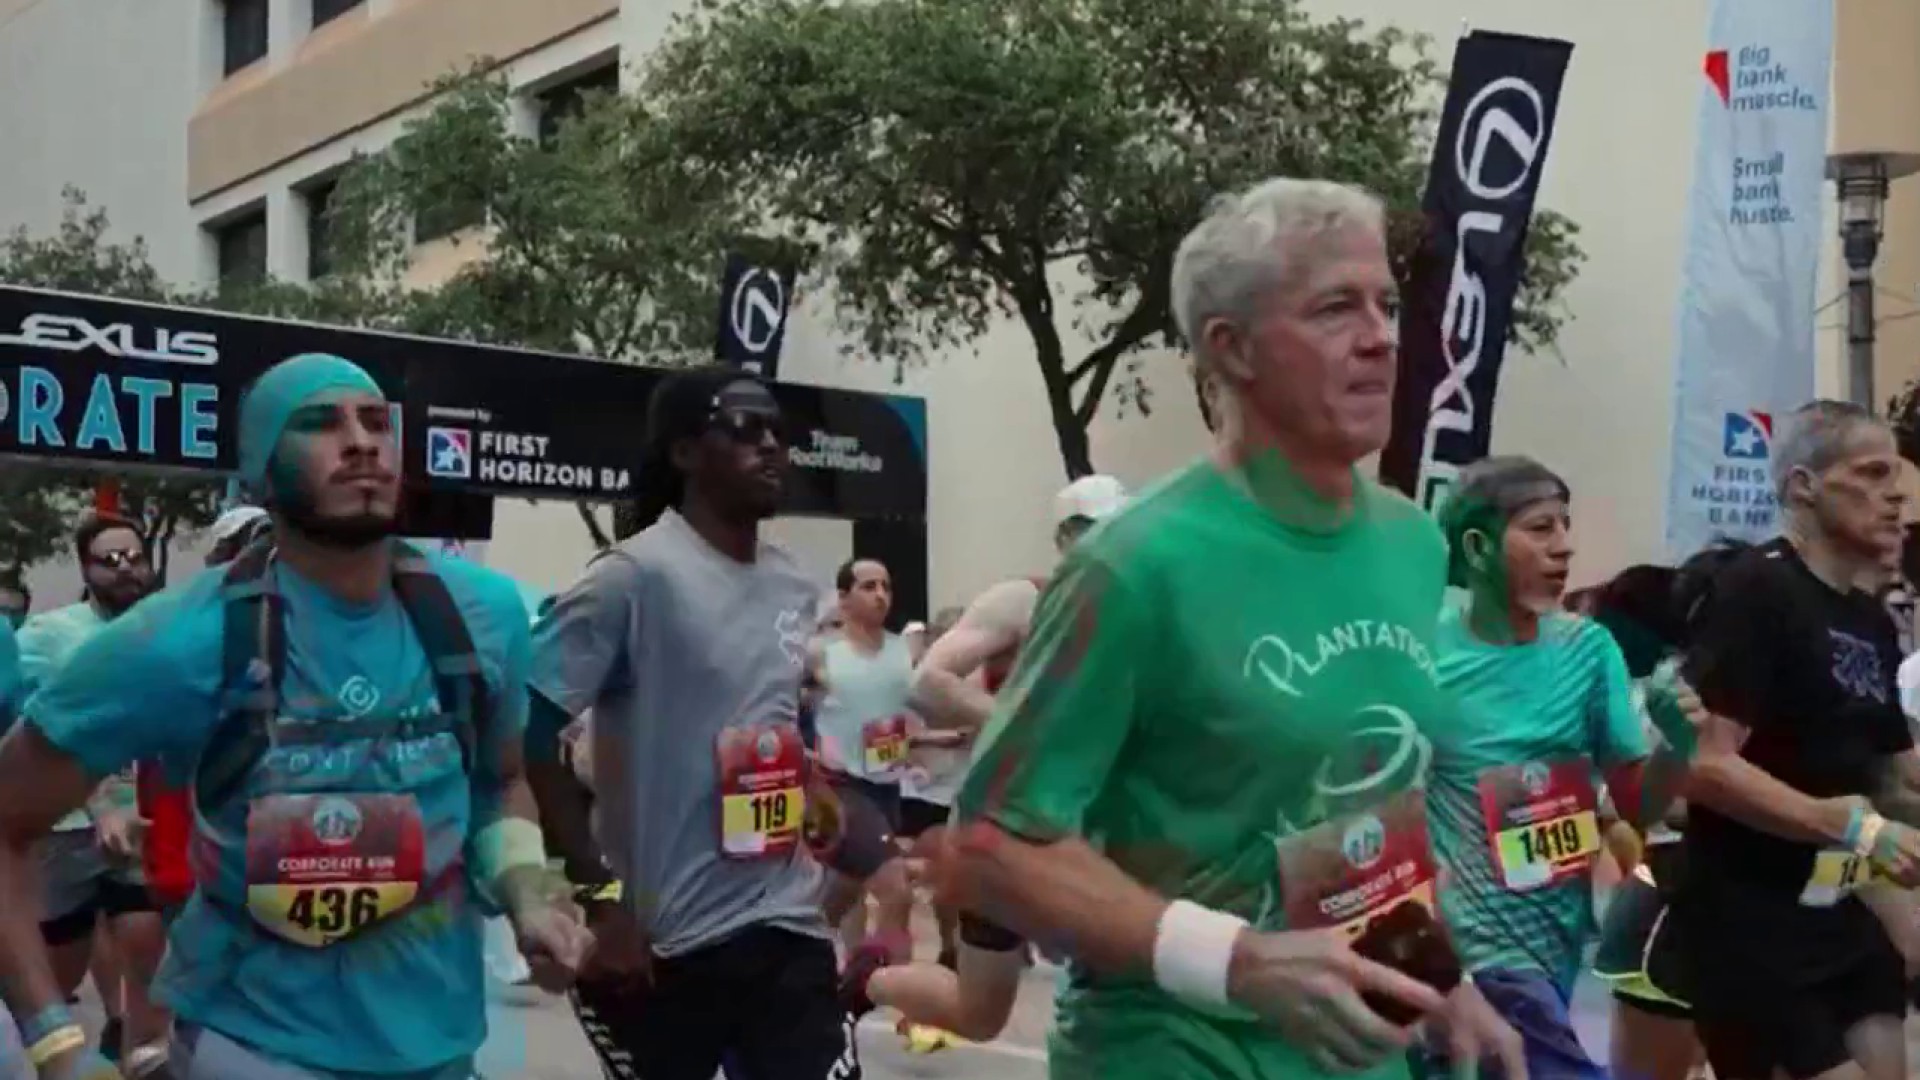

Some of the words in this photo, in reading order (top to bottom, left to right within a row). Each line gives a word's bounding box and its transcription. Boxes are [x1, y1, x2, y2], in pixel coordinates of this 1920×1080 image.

[1738, 46, 1769, 67] Big
[1732, 151, 1784, 179] Small
[479, 430, 549, 457] FIRST
[479, 458, 593, 488] HORIZON
[1713, 464, 1766, 484] FIRS
[751, 793, 787, 832] 119
[1519, 819, 1581, 864] 1419
[287, 887, 380, 932] 436
